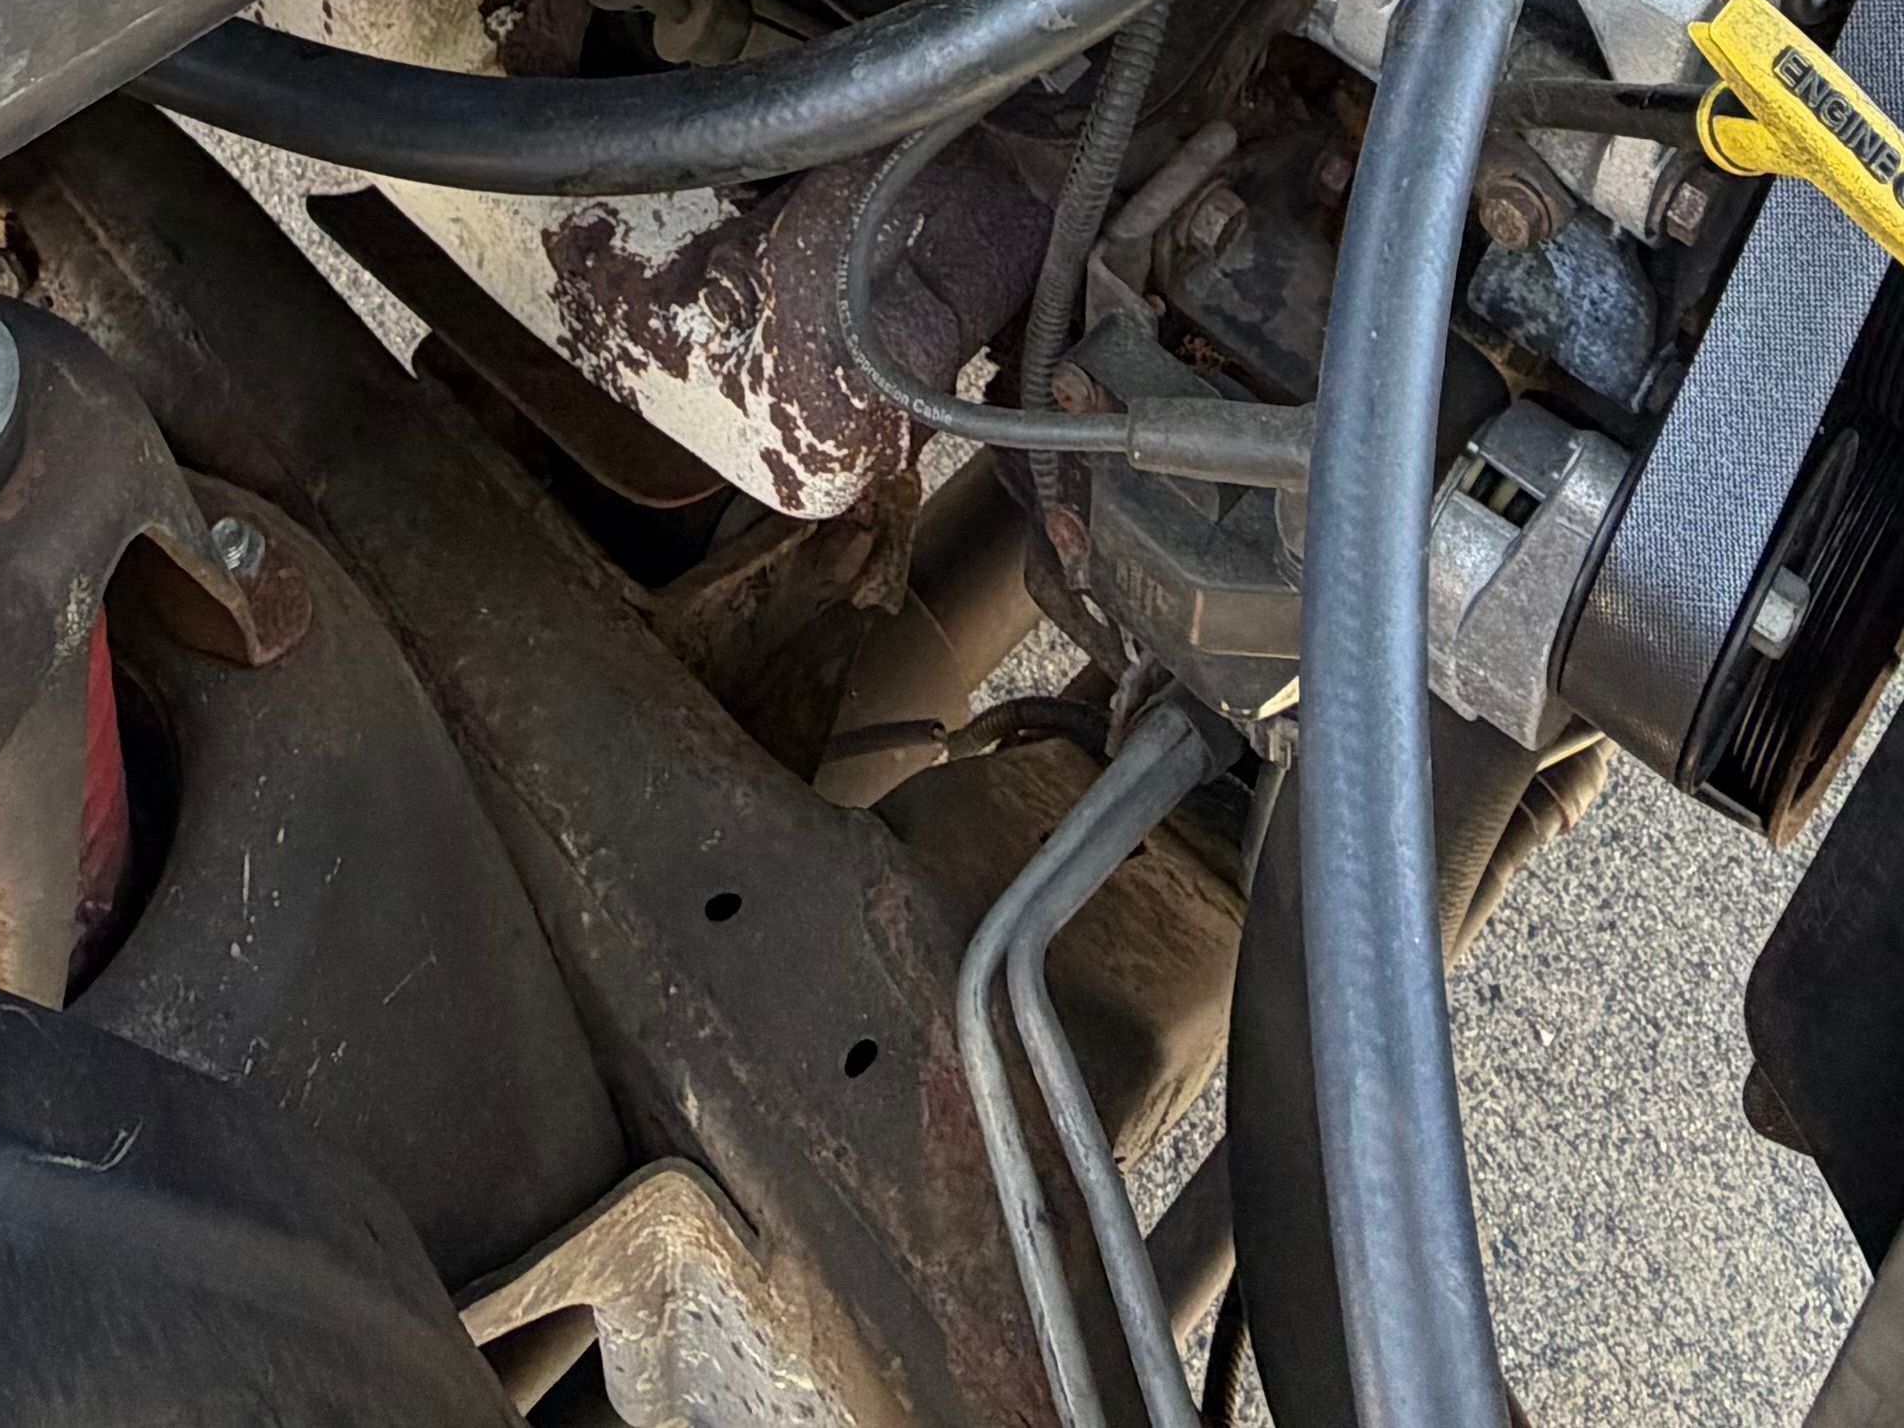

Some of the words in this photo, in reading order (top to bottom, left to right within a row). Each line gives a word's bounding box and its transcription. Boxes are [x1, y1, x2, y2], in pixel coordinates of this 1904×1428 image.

[1772, 45, 1904, 185] ENGINE
[847, 332, 911, 406] Suppression
[912, 398, 954, 426] Cable
